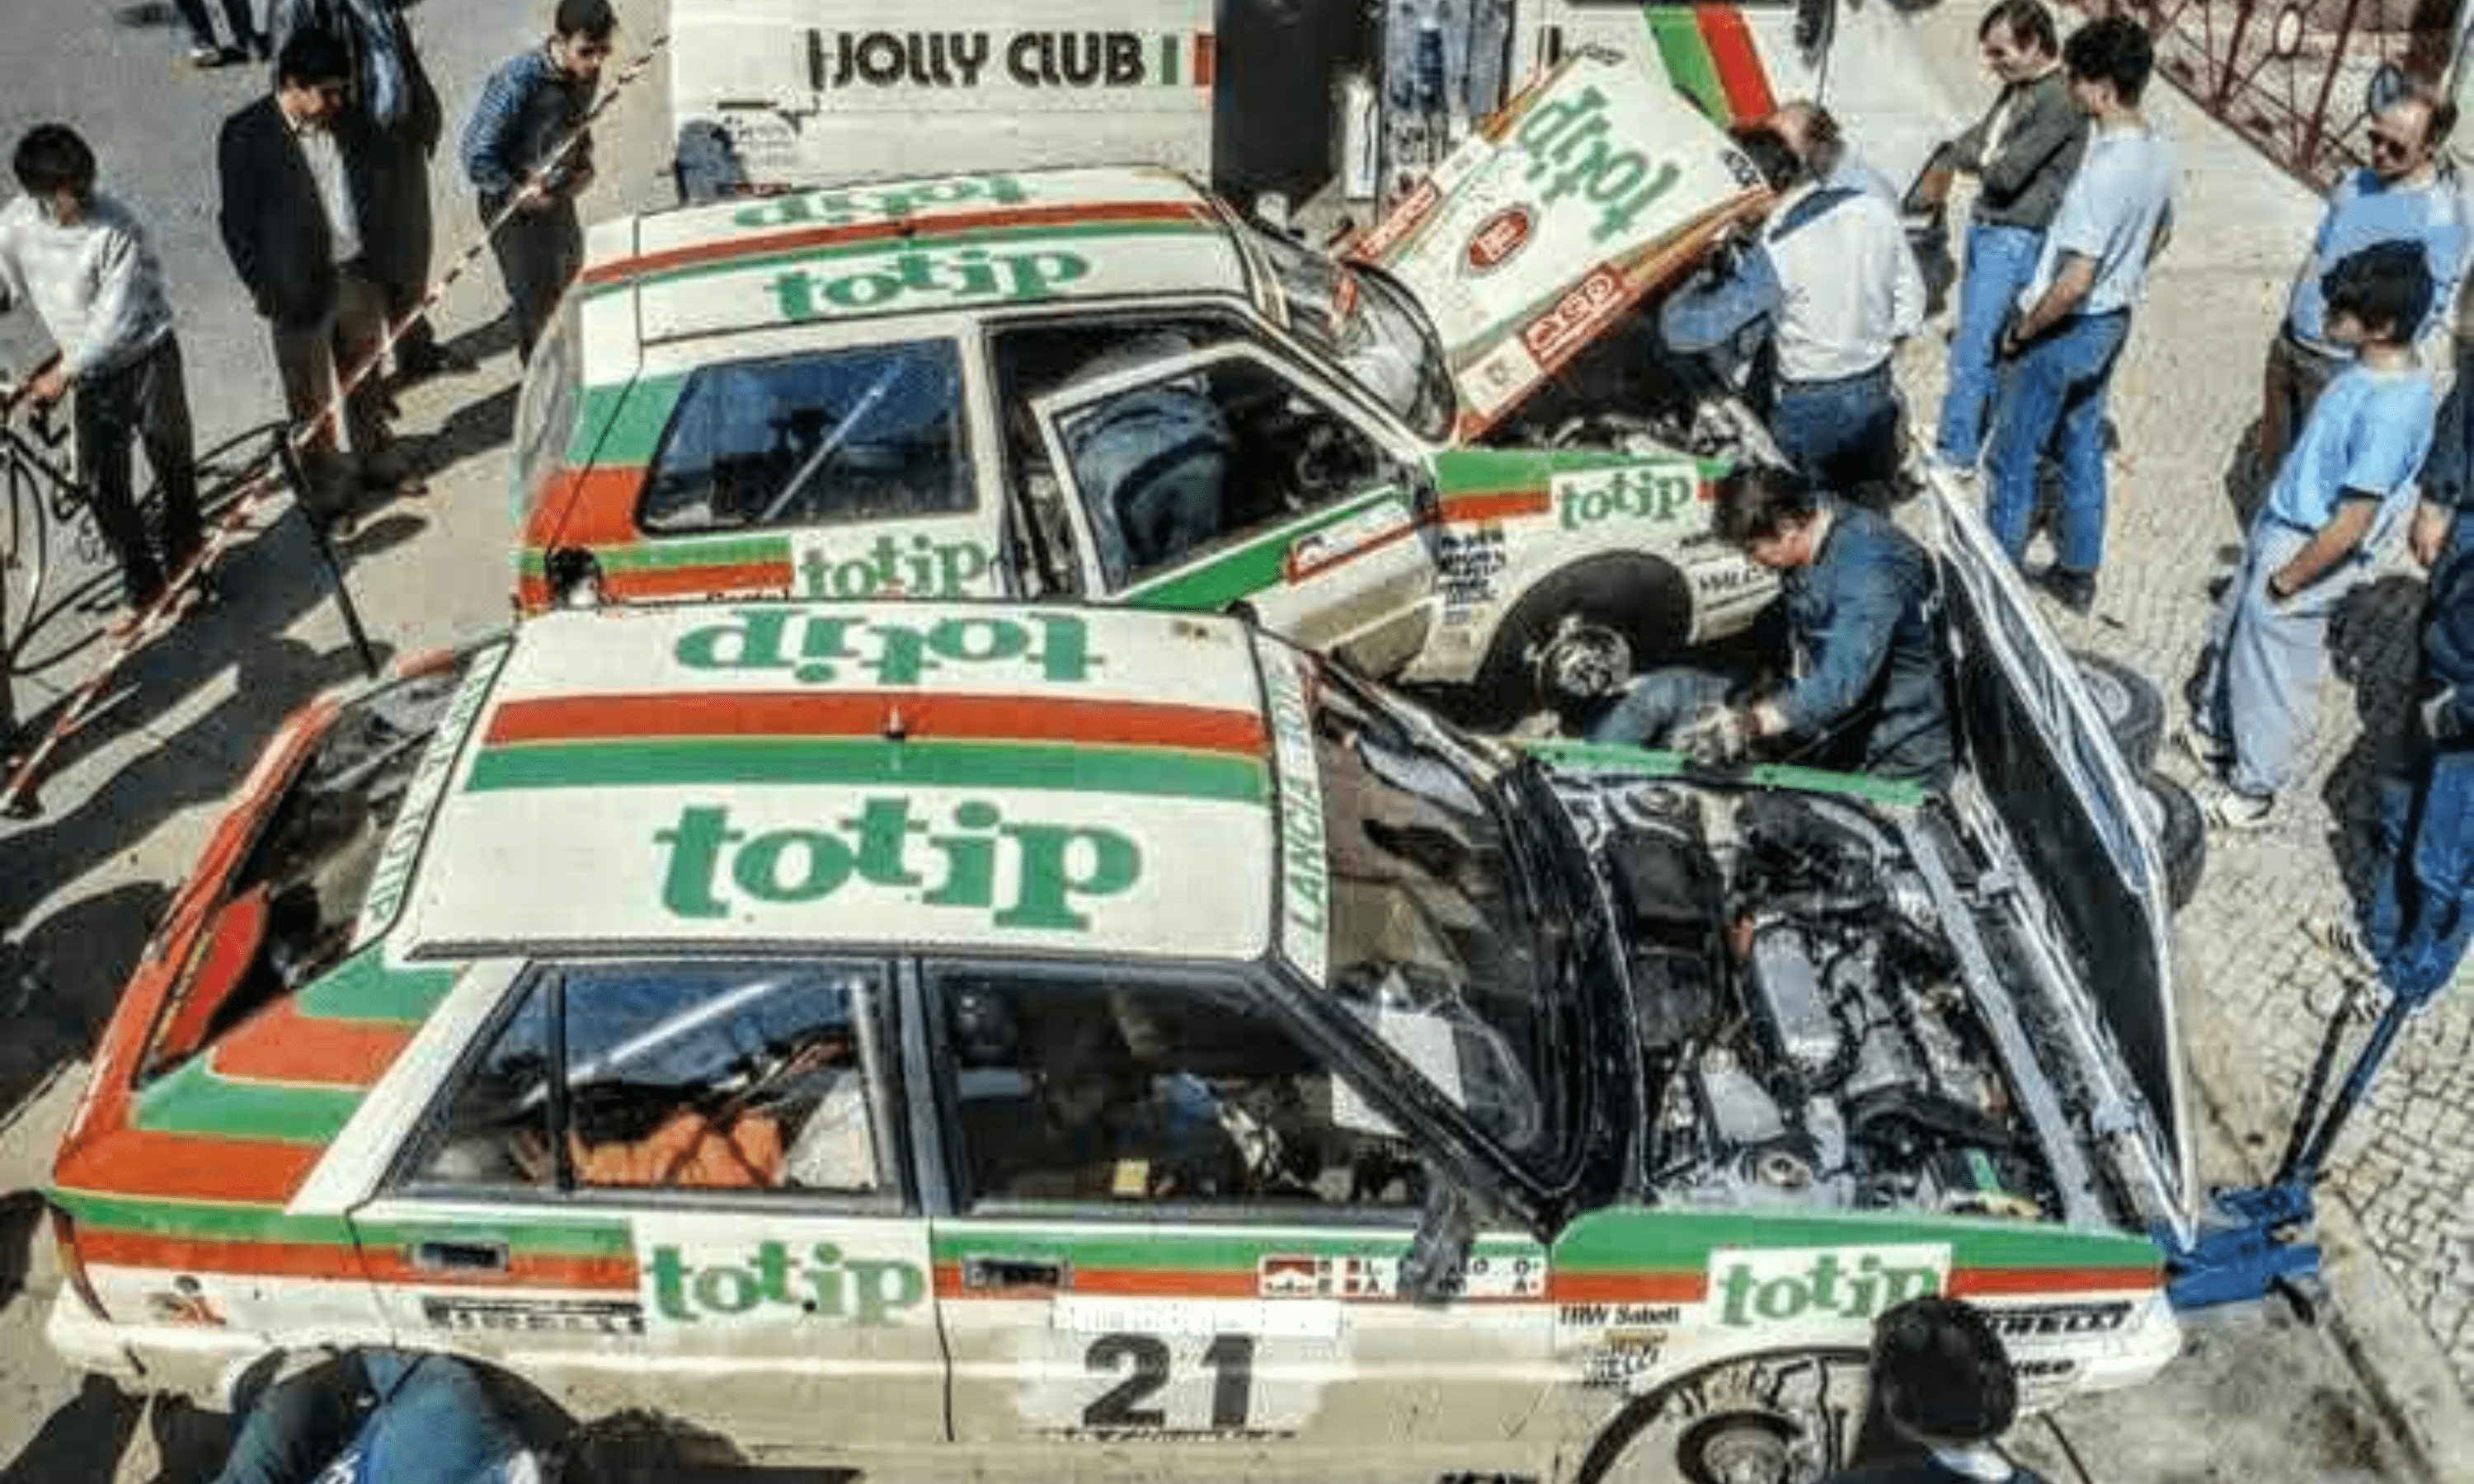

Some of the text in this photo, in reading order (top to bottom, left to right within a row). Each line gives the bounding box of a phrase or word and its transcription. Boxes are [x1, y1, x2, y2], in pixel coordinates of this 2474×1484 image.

[835, 31, 1146, 87] JOLLY CLUB
[1519, 85, 1681, 243] totip
[764, 250, 1089, 322] totip
[1555, 471, 1691, 531] totip
[800, 534, 988, 599] totip
[675, 608, 1103, 686] totip
[652, 797, 1143, 932] totip
[1283, 777, 1324, 935] LANCIA
[644, 1241, 926, 1327] totip
[1084, 1332, 1255, 1428] 21
